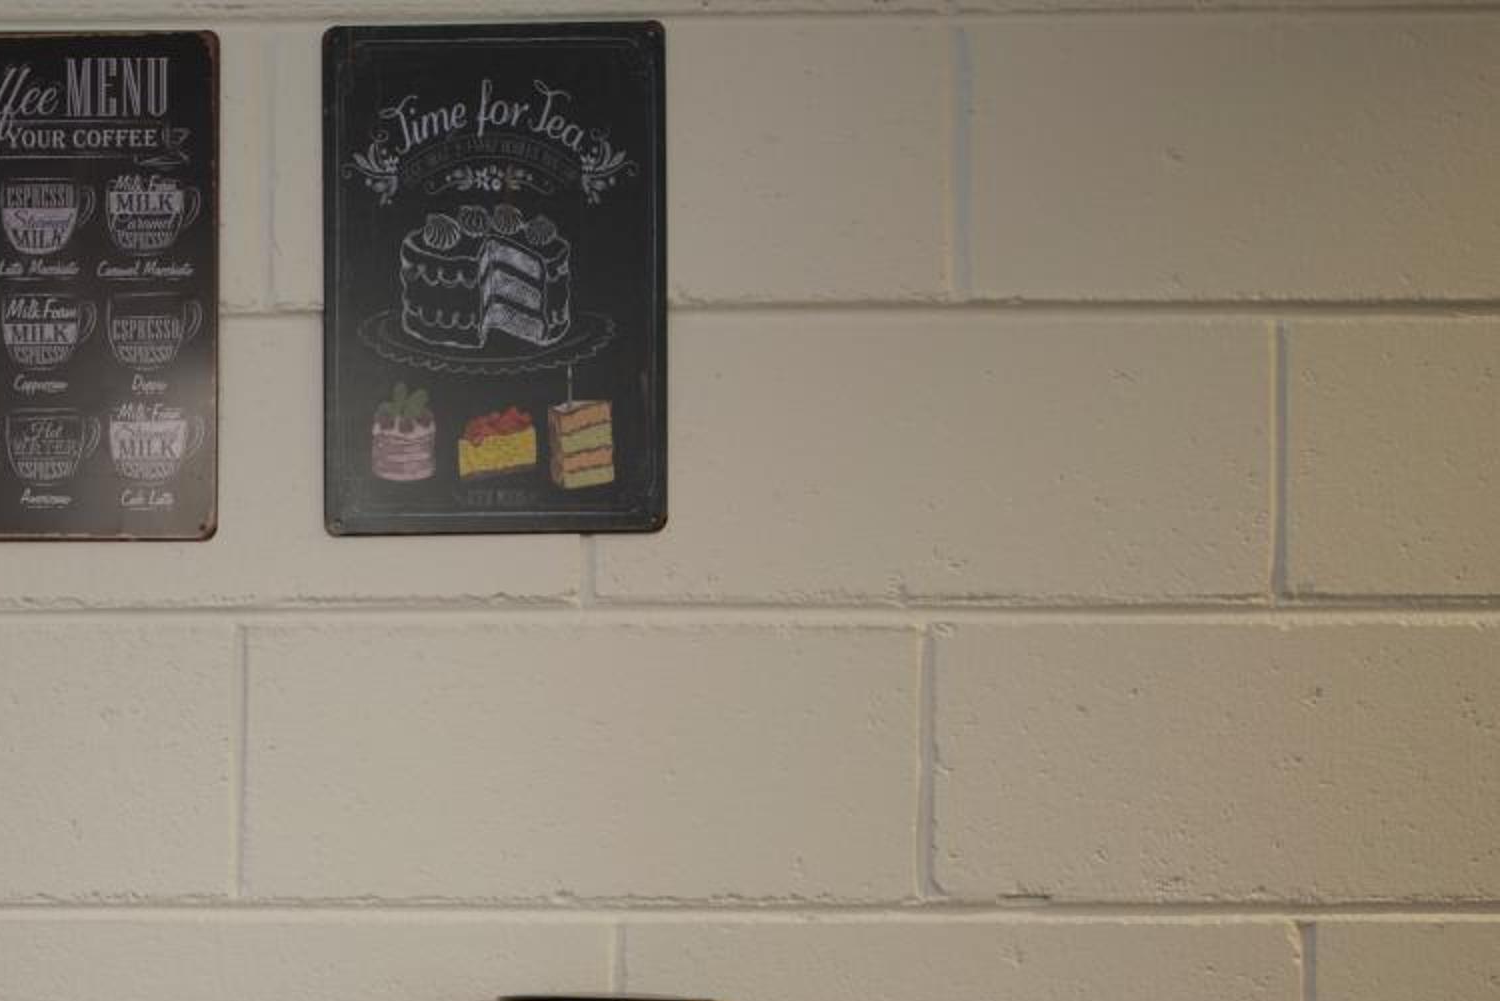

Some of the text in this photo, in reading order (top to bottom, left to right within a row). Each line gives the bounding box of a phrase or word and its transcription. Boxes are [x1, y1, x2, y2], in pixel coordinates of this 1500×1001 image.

[65, 57, 169, 117] MENU
[379, 95, 467, 154] Time
[477, 79, 530, 137] for
[529, 79, 585, 151] Tea
[6, 128, 66, 149] YOUR
[73, 128, 159, 147] COFFEE
[117, 193, 173, 212] MILK
[5, 298, 77, 320] Milk Foam
[12, 323, 69, 342] MILK
[113, 319, 180, 340] ESPRESSO
